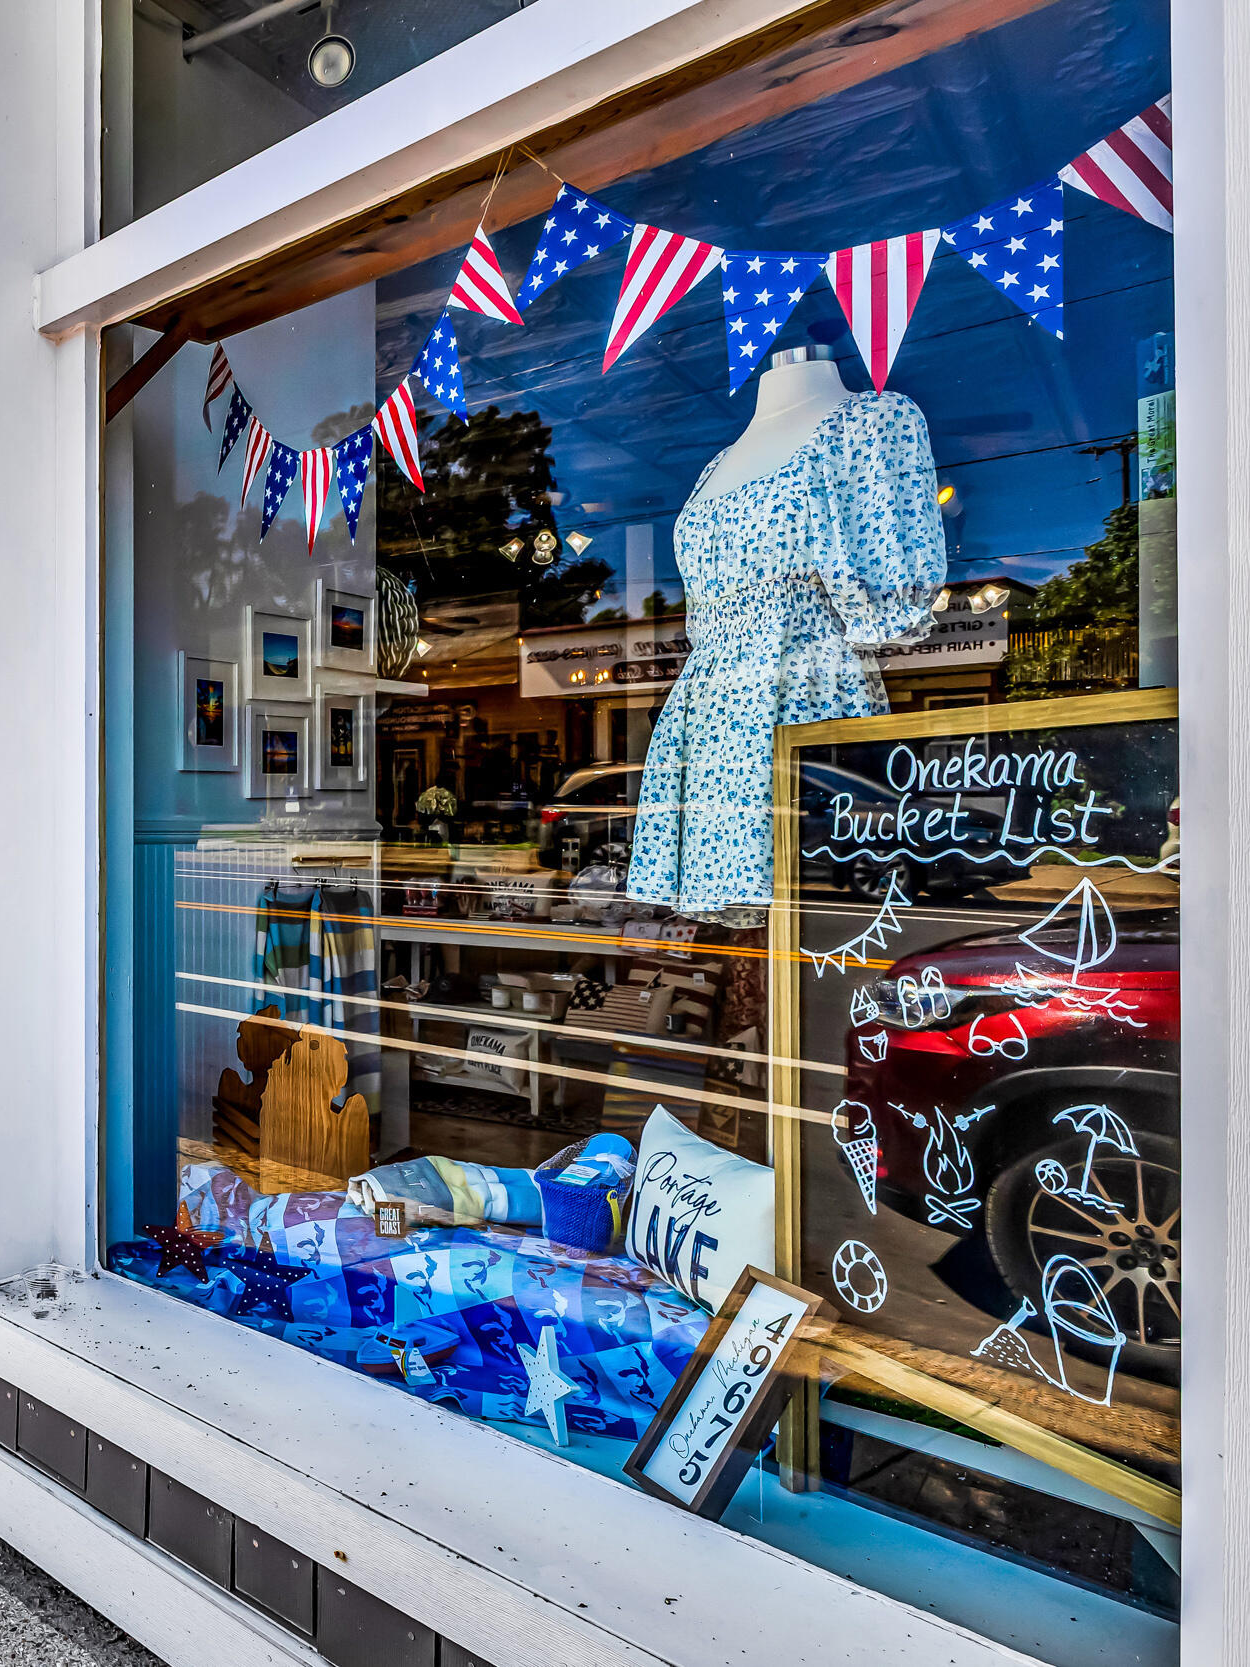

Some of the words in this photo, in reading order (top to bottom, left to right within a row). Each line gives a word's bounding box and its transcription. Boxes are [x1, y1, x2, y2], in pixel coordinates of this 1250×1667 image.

[1147, 424, 1156, 447] Great
[886, 736, 1086, 793] Onekama
[830, 791, 970, 847] Bucket
[999, 787, 1113, 846] List
[470, 1035, 507, 1056] ONEKAMA
[379, 1207, 400, 1221] GREAT
[639, 1151, 722, 1234] Portage
[379, 1221, 402, 1235] COAST
[631, 1190, 719, 1316] LAKE
[711, 1317, 760, 1390] Michigan
